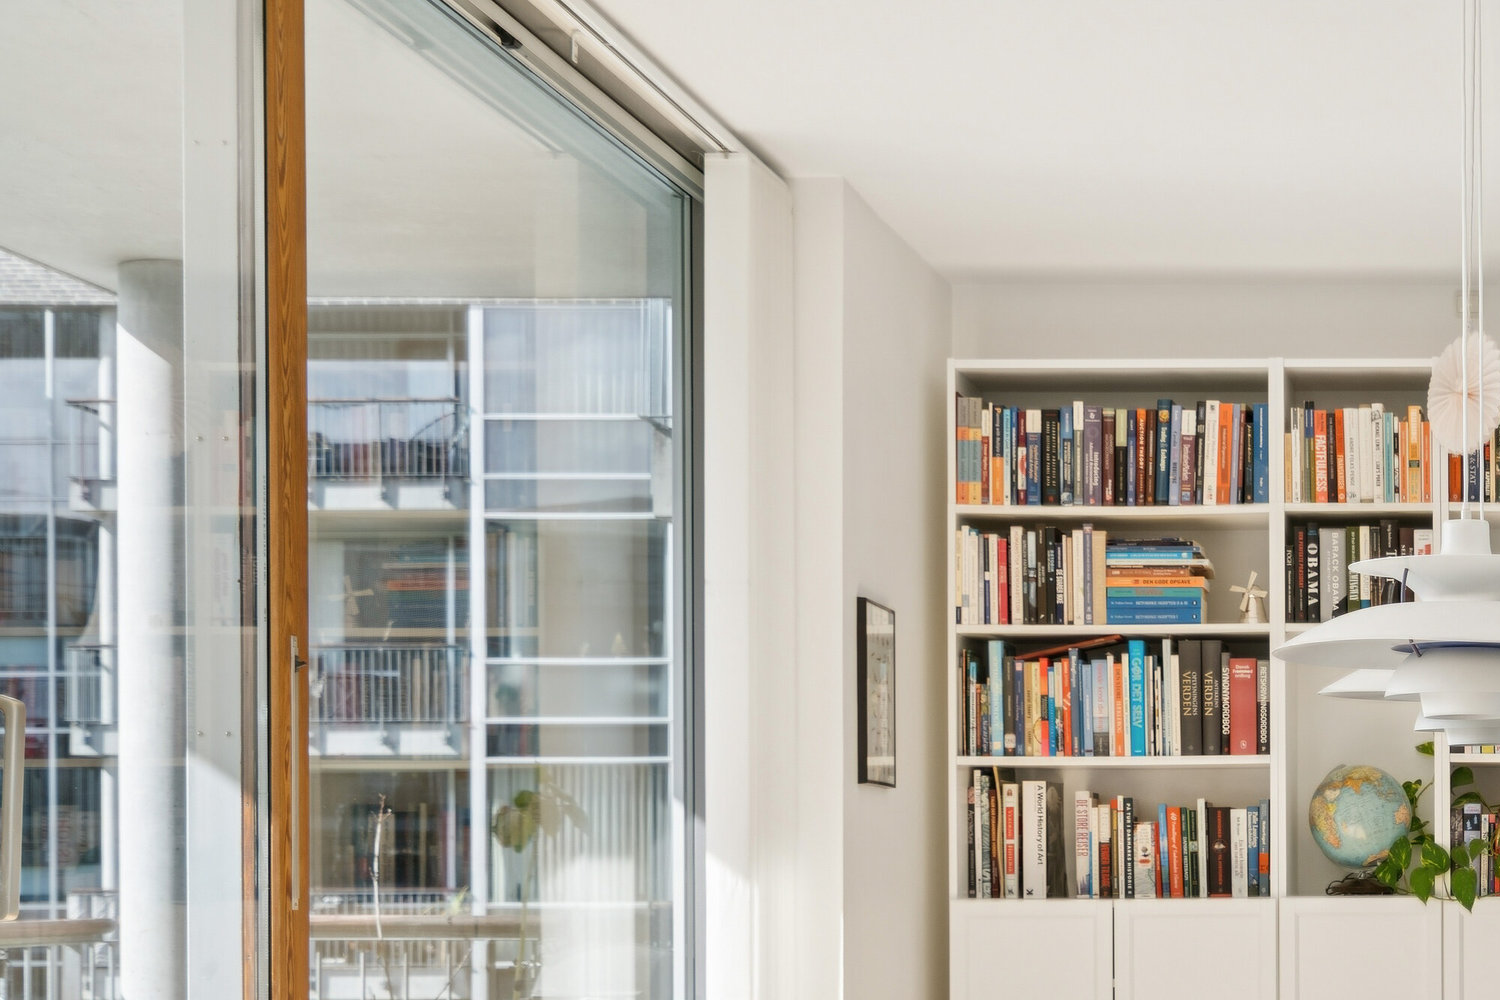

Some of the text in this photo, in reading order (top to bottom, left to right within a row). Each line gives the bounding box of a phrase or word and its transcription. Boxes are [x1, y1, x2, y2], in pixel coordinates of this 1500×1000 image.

[1316, 434, 1327, 492] FACTFULNESS
[1308, 542, 1318, 606] OBAMA
[1330, 532, 1340, 611] BARACK OBAMA
[1132, 658, 1142, 728] GØR DET SELV
[1182, 671, 1192, 716] VERDEN
[1204, 671, 1213, 716] VERDEN
[1076, 800, 1088, 857] DE STORE REJSER
[1170, 812, 1177, 821] 40
[1037, 844, 1043, 853] of
